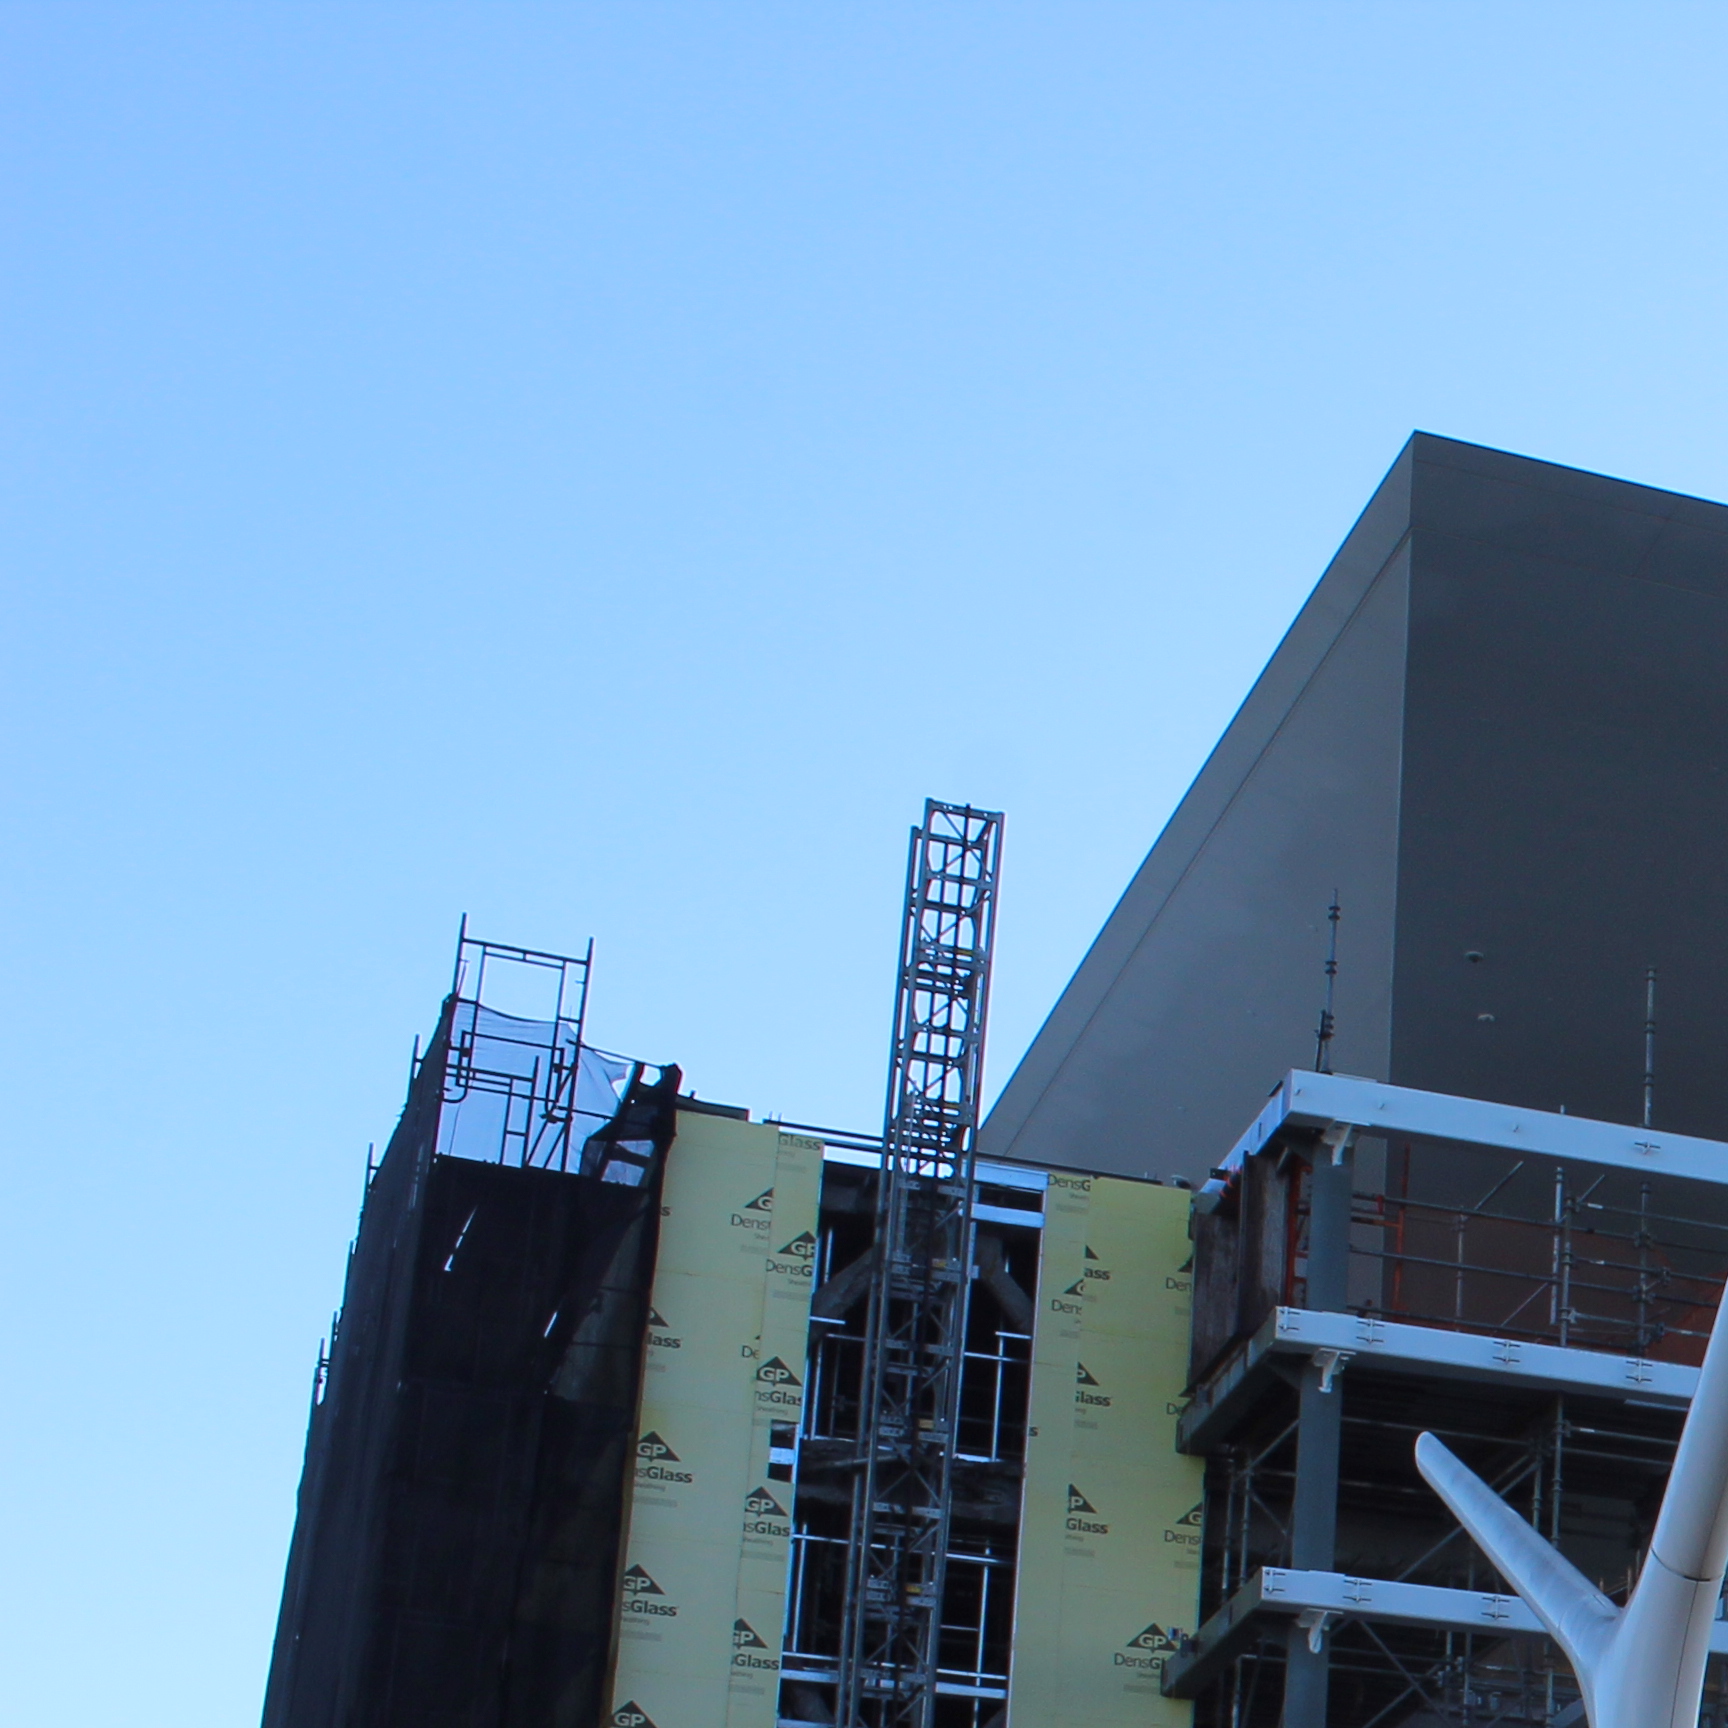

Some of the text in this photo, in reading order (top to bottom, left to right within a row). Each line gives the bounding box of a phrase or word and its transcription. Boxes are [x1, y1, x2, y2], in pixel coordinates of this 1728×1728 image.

[778, 1134, 821, 1152] Glass
[765, 1258, 813, 1276] DensG
[760, 1366, 790, 1381] GP
[637, 1442, 668, 1456] GP
[1066, 1517, 1107, 1535] Glass
[622, 1601, 678, 1617] sGlass
[1139, 1633, 1168, 1648] GP
[732, 1652, 781, 1671] Glass
[1114, 1652, 1166, 1670] DensGl
[617, 1711, 647, 1727] GP
